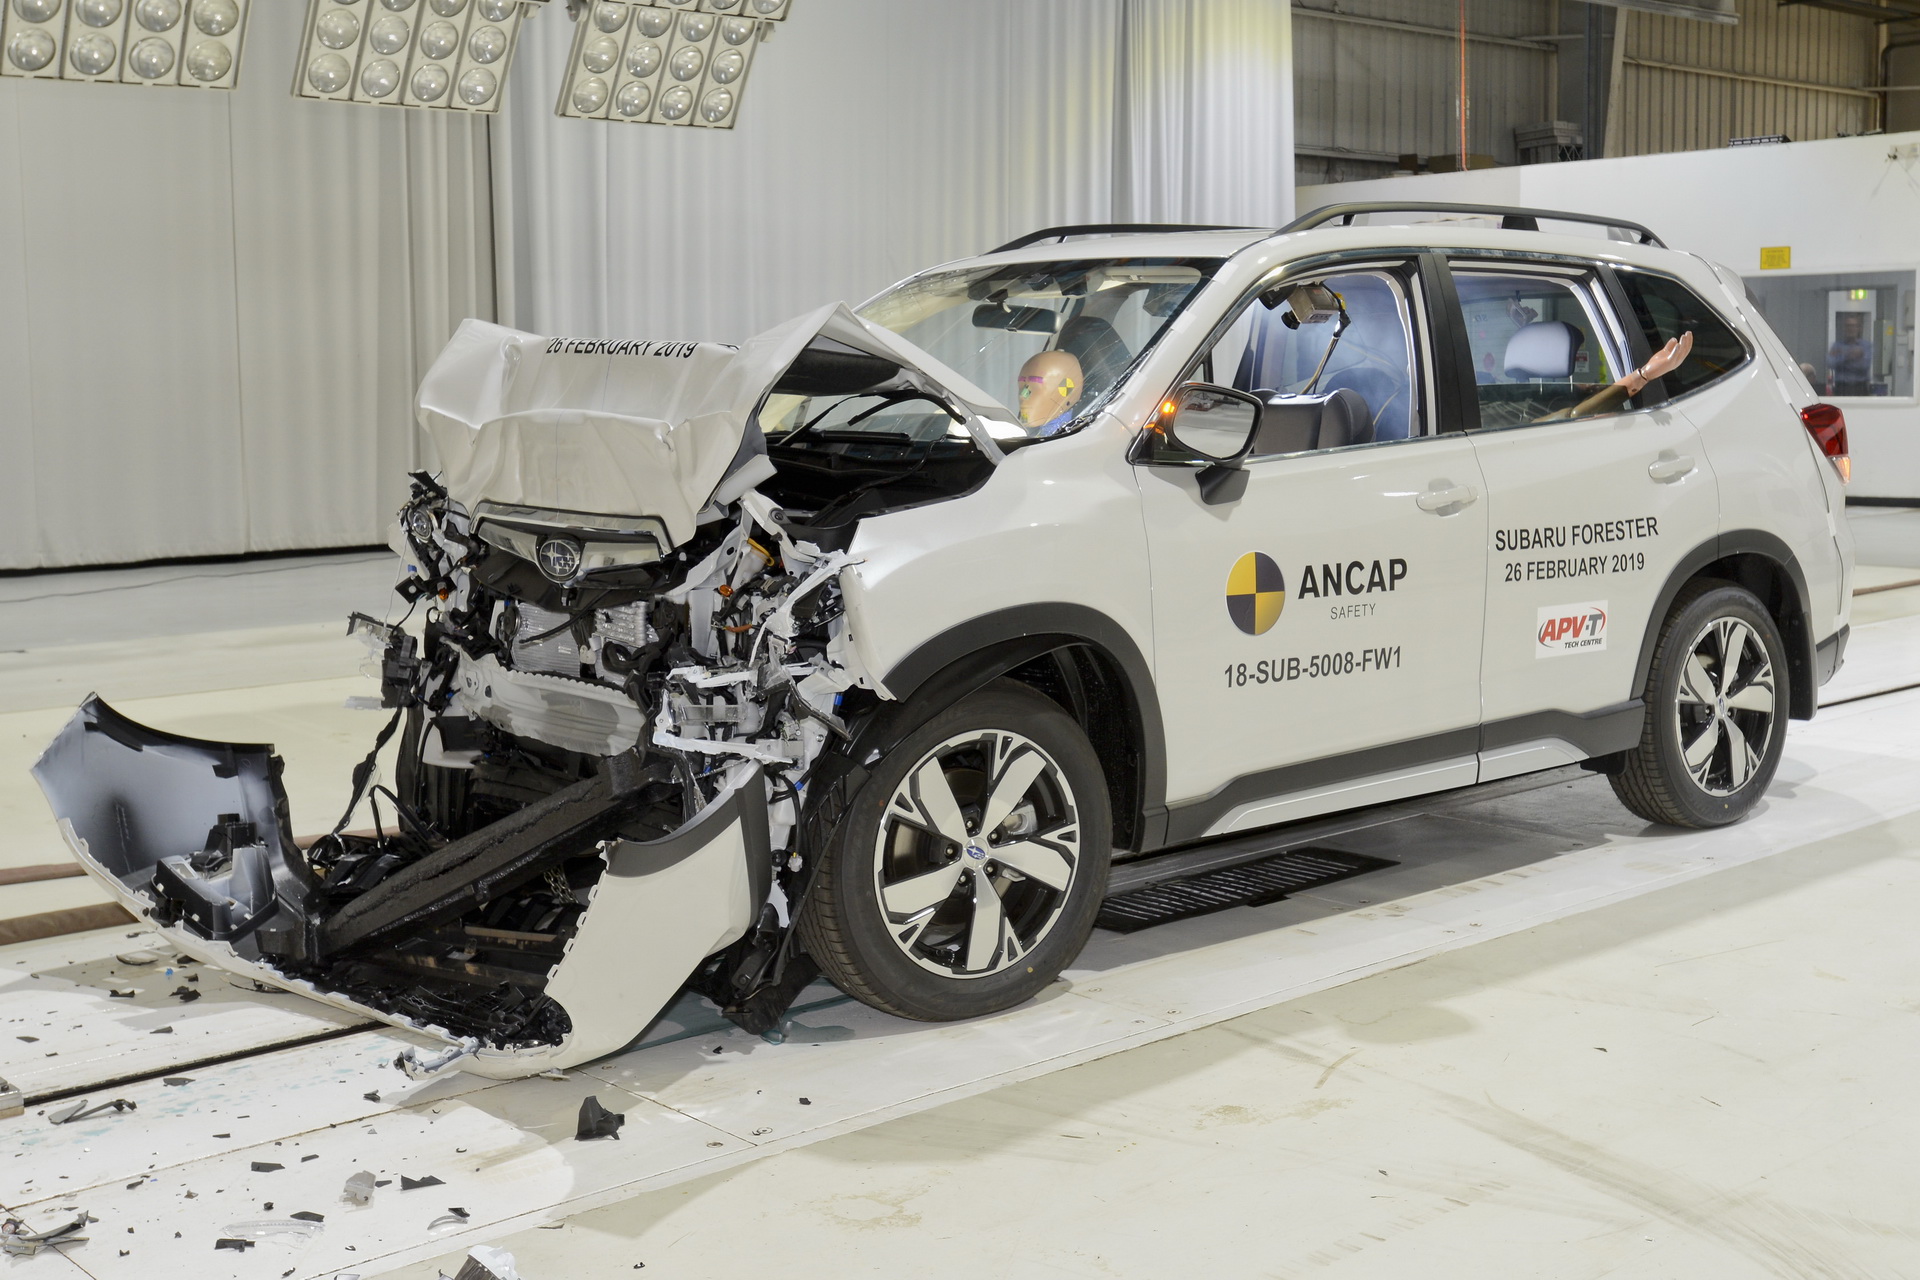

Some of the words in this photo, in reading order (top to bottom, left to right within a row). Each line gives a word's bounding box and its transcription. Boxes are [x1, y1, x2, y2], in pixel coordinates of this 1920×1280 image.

[546, 338, 567, 354] 26
[565, 338, 656, 356] FEBRUARY
[653, 341, 699, 358] 2019
[1495, 526, 1566, 551] SUBARU
[1572, 516, 1659, 546] FORESTER
[1298, 558, 1408, 600] ANCAP
[1505, 562, 1522, 582] 26
[1527, 556, 1608, 581] FEBRUARY
[1612, 552, 1645, 573] 2019
[1330, 603, 1377, 620] SAFETY
[1564, 641, 1580, 649] TECH
[1580, 637, 1603, 647] CENTRE
[1224, 645, 1401, 688] 18-SUB-5008-FW1
